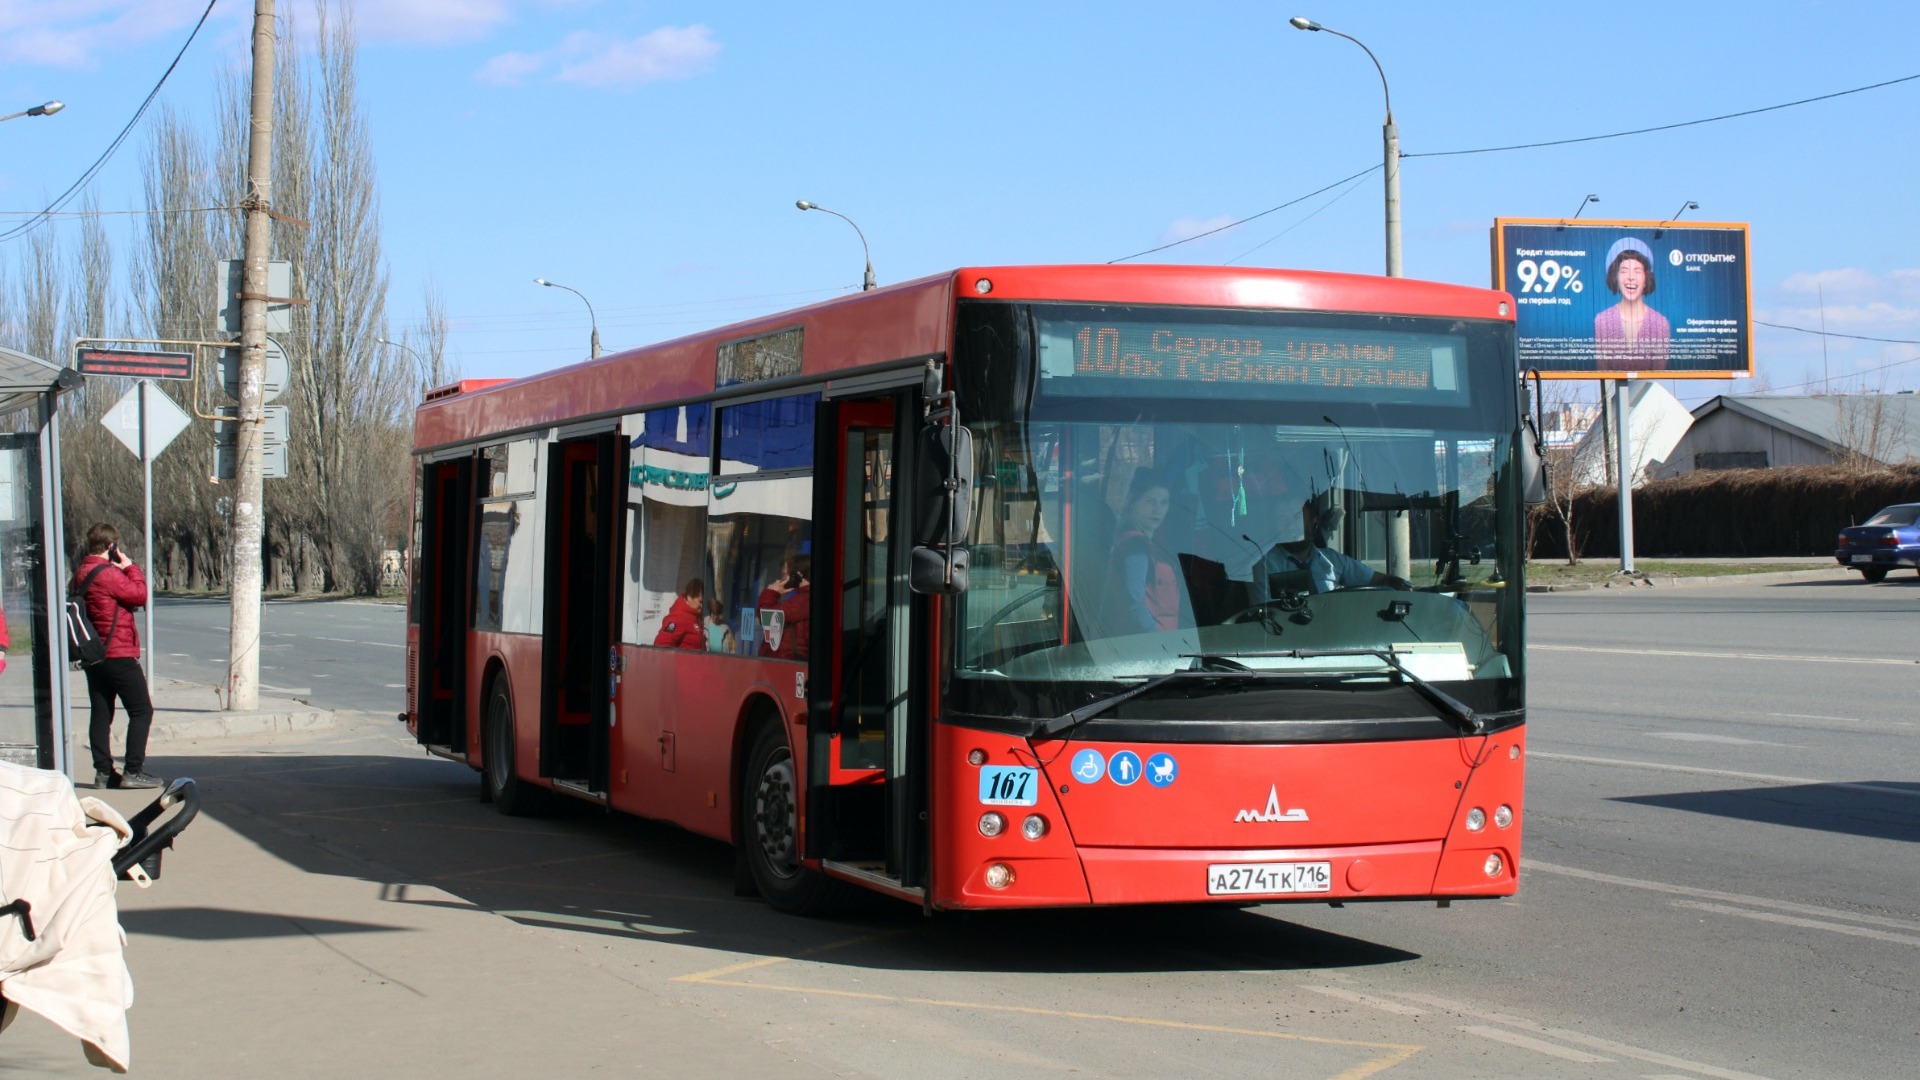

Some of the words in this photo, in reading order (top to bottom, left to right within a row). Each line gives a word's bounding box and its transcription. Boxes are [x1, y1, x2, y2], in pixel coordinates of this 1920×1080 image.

[1516, 248, 1543, 257] Кредит
[1685, 253, 1736, 265] открытие
[1529, 297, 1556, 305] первый
[1076, 326, 1118, 371] 10
[1152, 330, 1262, 356] Серов
[1287, 341, 1394, 361] урамы
[1321, 367, 1428, 387] урамы
[989, 771, 1031, 800] 167
[1297, 866, 1326, 883] 716
